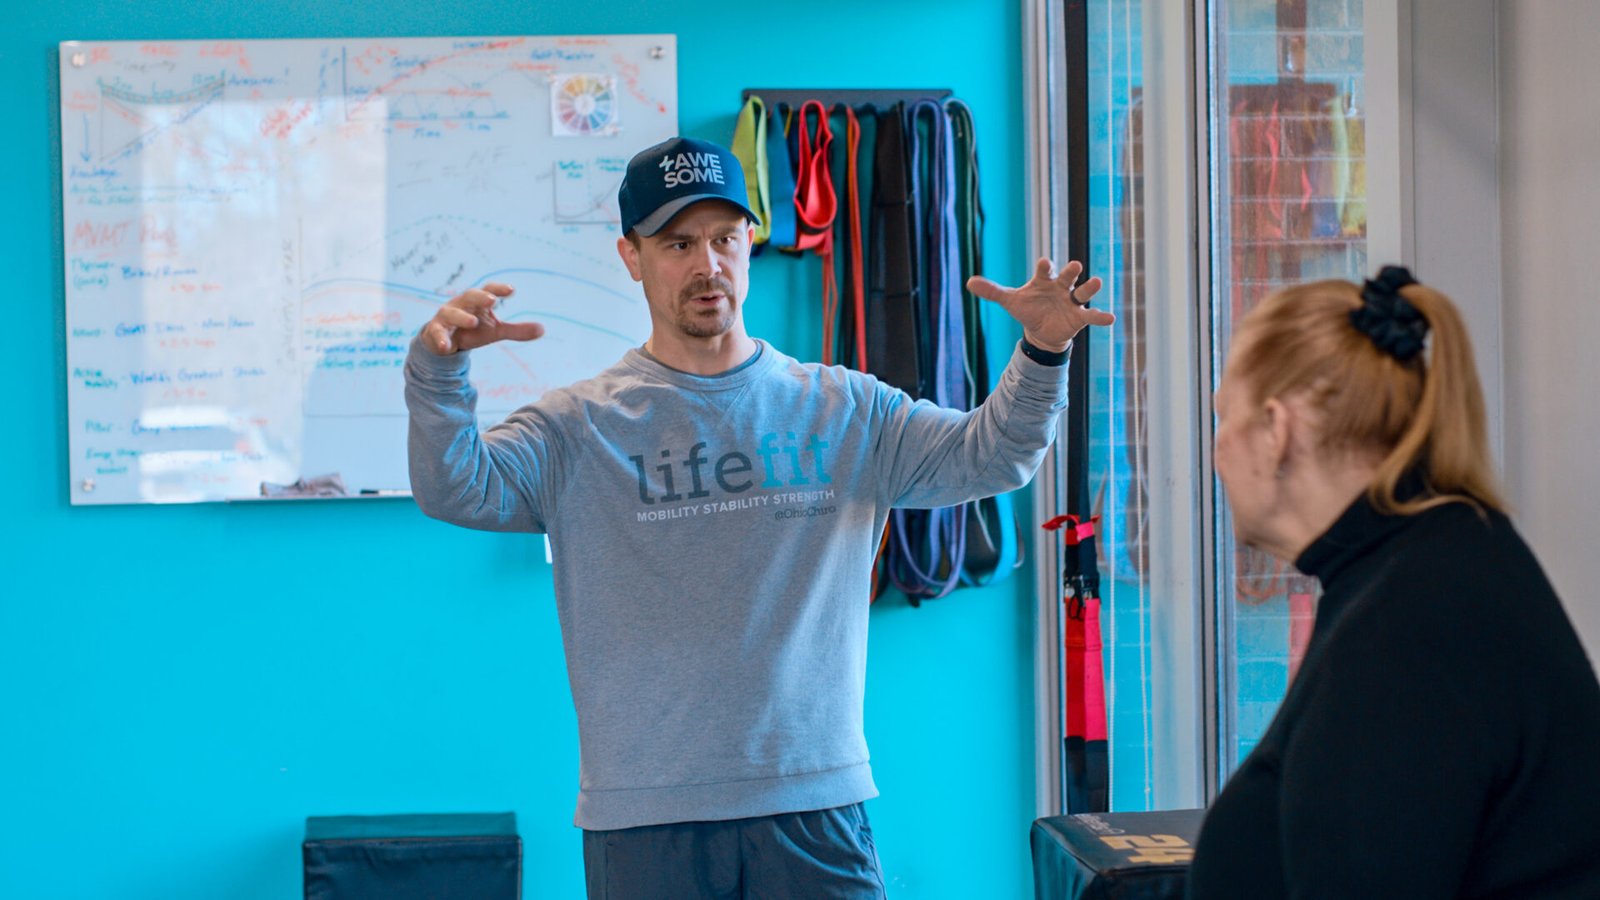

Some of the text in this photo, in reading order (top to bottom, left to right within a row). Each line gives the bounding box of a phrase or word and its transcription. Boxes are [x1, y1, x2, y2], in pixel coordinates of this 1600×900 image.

[664, 168, 725, 189] SOME
[629, 432, 832, 505] lifefit
[637, 489, 835, 522] MOBILITY STABILITY STRENGTH
[774, 504, 837, 521] @OhioChiro
